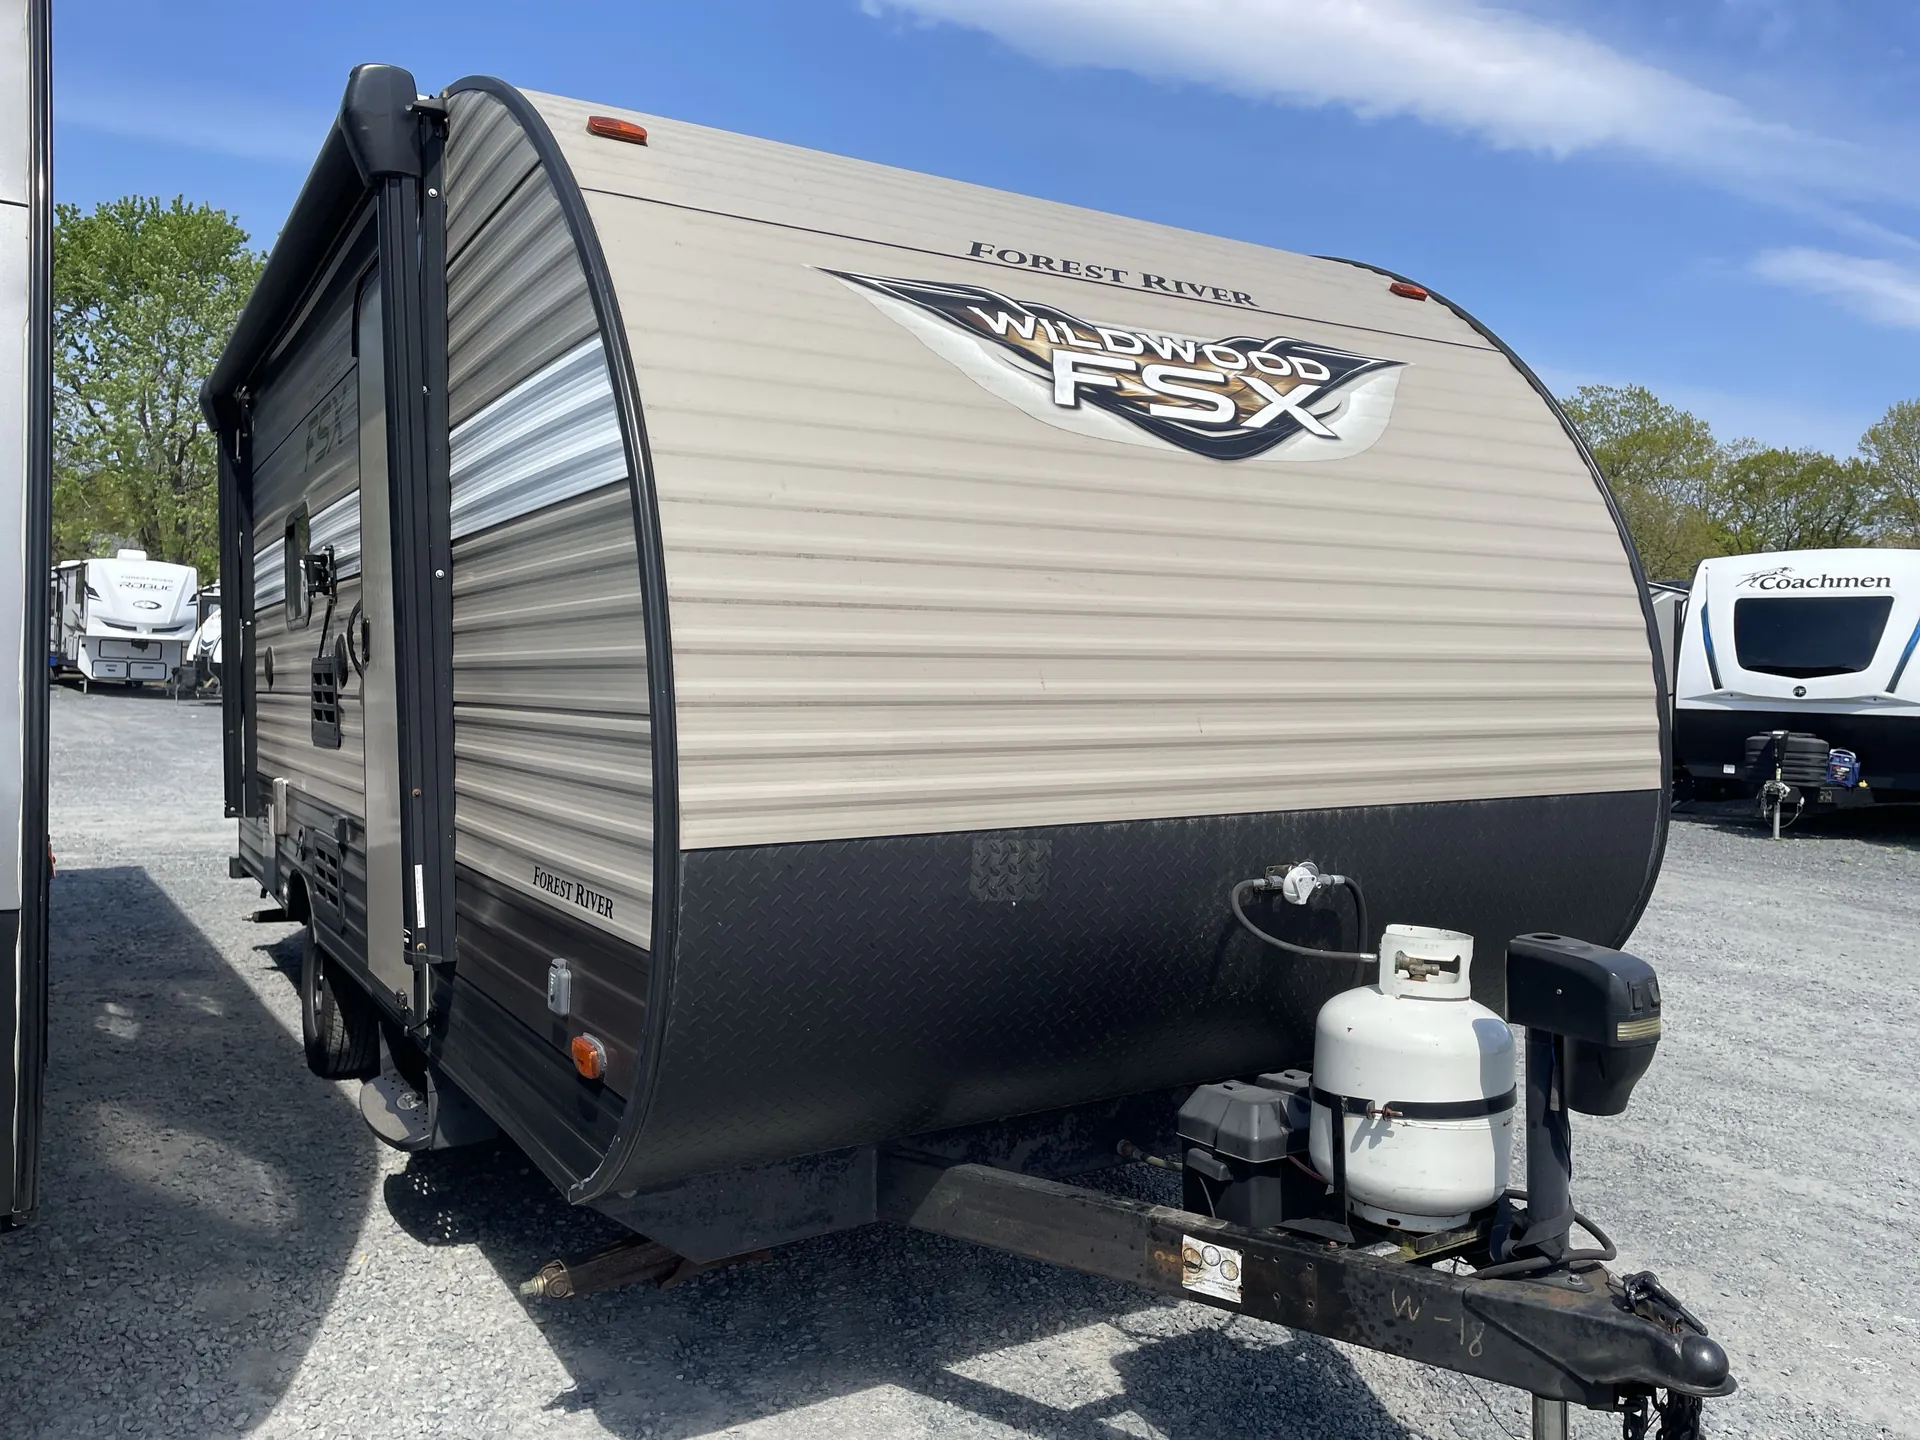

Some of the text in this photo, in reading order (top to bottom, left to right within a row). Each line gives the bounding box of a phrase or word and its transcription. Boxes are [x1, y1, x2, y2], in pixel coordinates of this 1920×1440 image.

[967, 241, 1255, 306] FOREST RIVER
[967, 305, 1332, 382] WILDWOOD
[303, 384, 347, 473] FSX
[1051, 349, 1338, 440] FSX
[1760, 574, 1891, 590] Coachmen
[532, 865, 614, 919] FOREST RIVER
